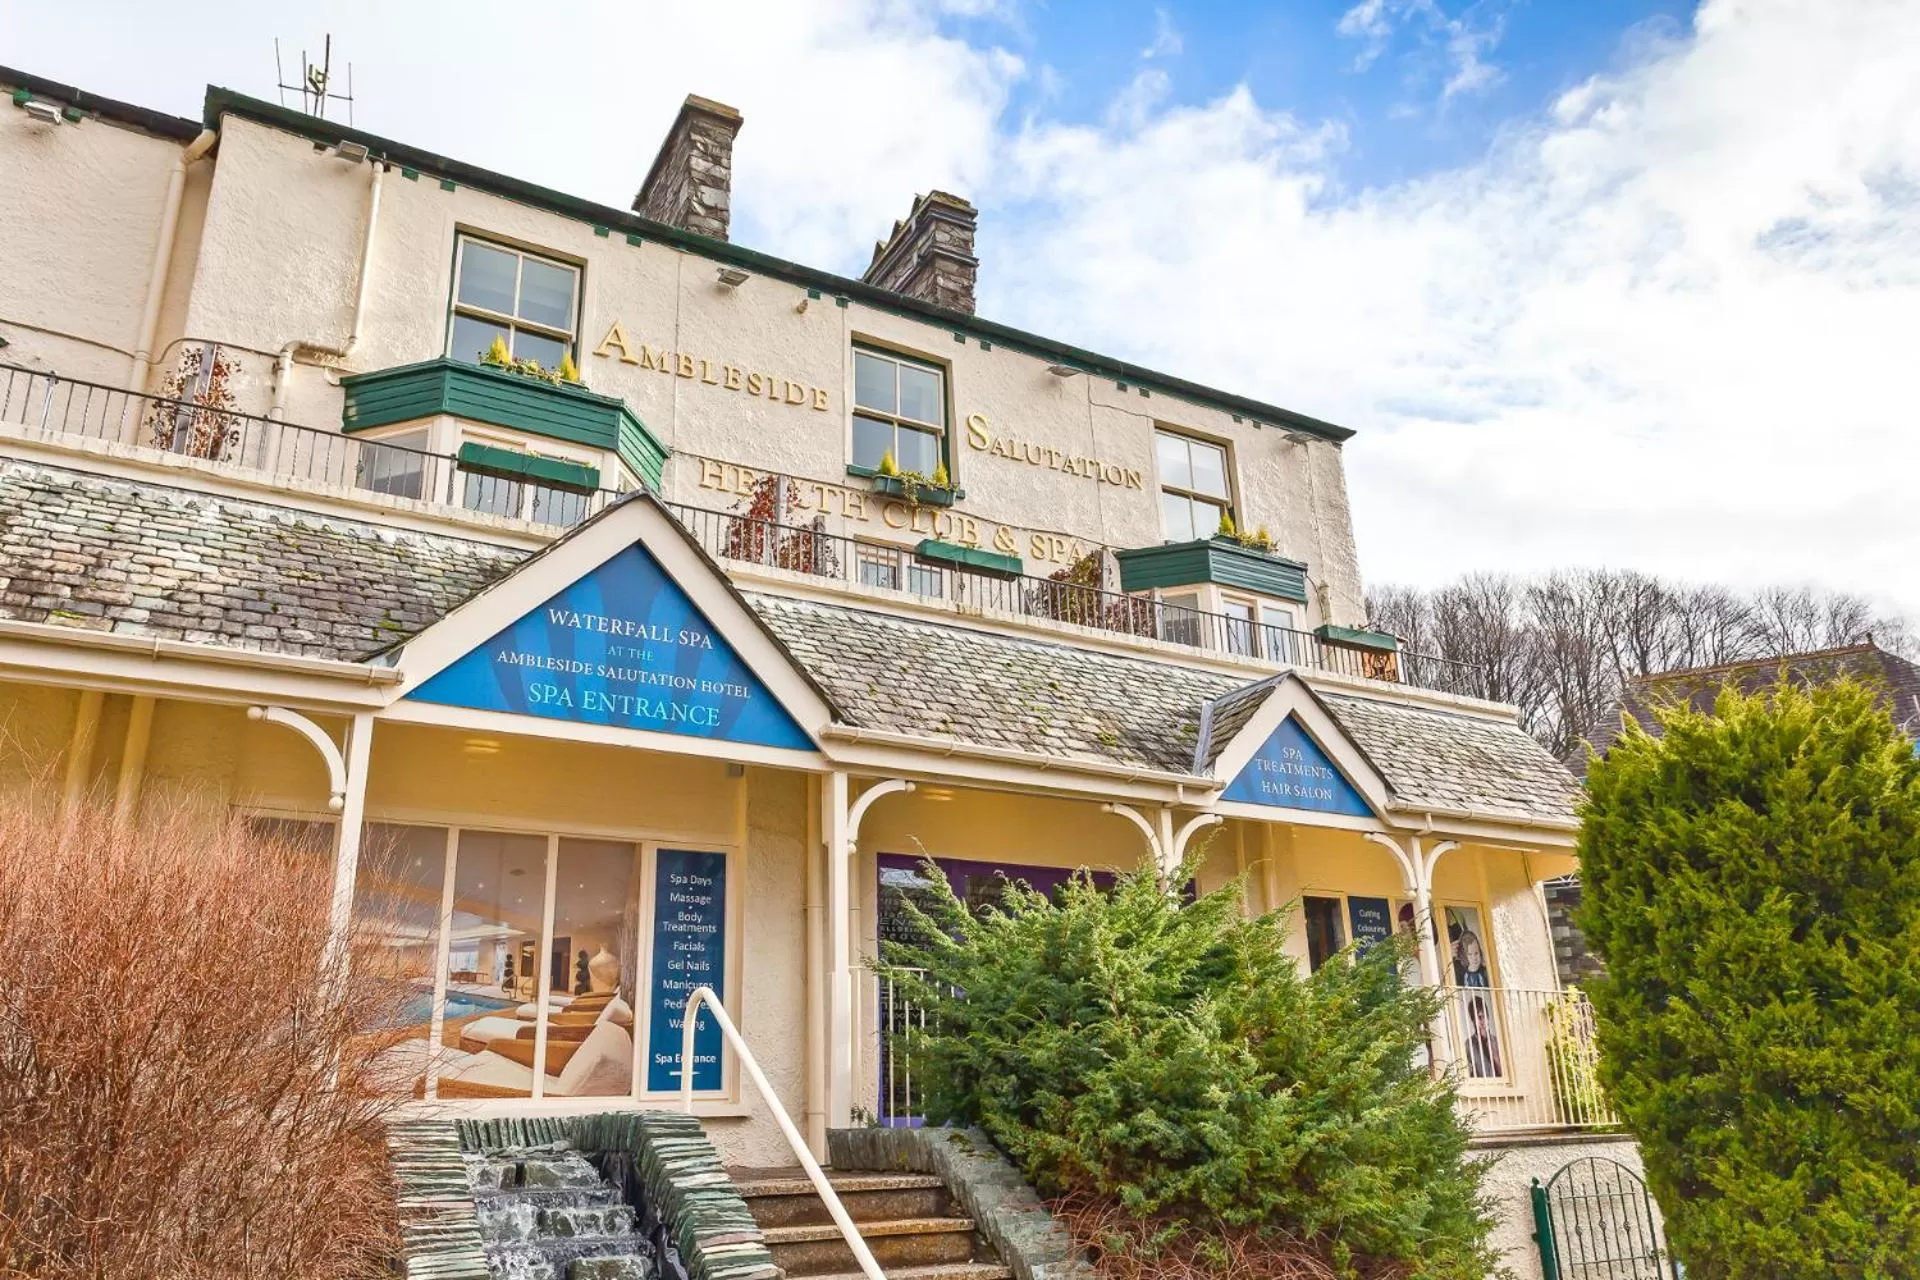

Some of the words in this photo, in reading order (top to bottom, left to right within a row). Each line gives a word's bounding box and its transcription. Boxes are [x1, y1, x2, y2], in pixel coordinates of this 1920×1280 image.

[882, 501, 979, 545] CLUB
[993, 525, 1019, 554] &
[1030, 534, 1087, 566] SPA
[549, 608, 674, 643] WATERFALL
[678, 630, 714, 650] SPA
[608, 645, 622, 657] AT
[628, 646, 655, 661] THE
[497, 650, 593, 676] AMBLESIDE
[597, 664, 697, 690] SALUTATION
[701, 680, 750, 698] HOTEL
[528, 682, 574, 708] SPA
[583, 690, 720, 727] ENTRANCE
[1282, 747, 1303, 761] SPA
[1256, 758, 1334, 779] TREATMENTS
[1262, 780, 1291, 796] HAIR
[1293, 784, 1332, 800] SALON
[670, 873, 688, 885] Spa
[690, 874, 713, 887] Days
[670, 892, 712, 905] Massage
[677, 911, 703, 923] Body
[662, 921, 717, 933] Treatments
[673, 941, 705, 952] Facials
[667, 960, 684, 970] Gel
[686, 960, 710, 971] Nails
[669, 1018, 705, 1031] Wang
[655, 1052, 672, 1065] Spa
